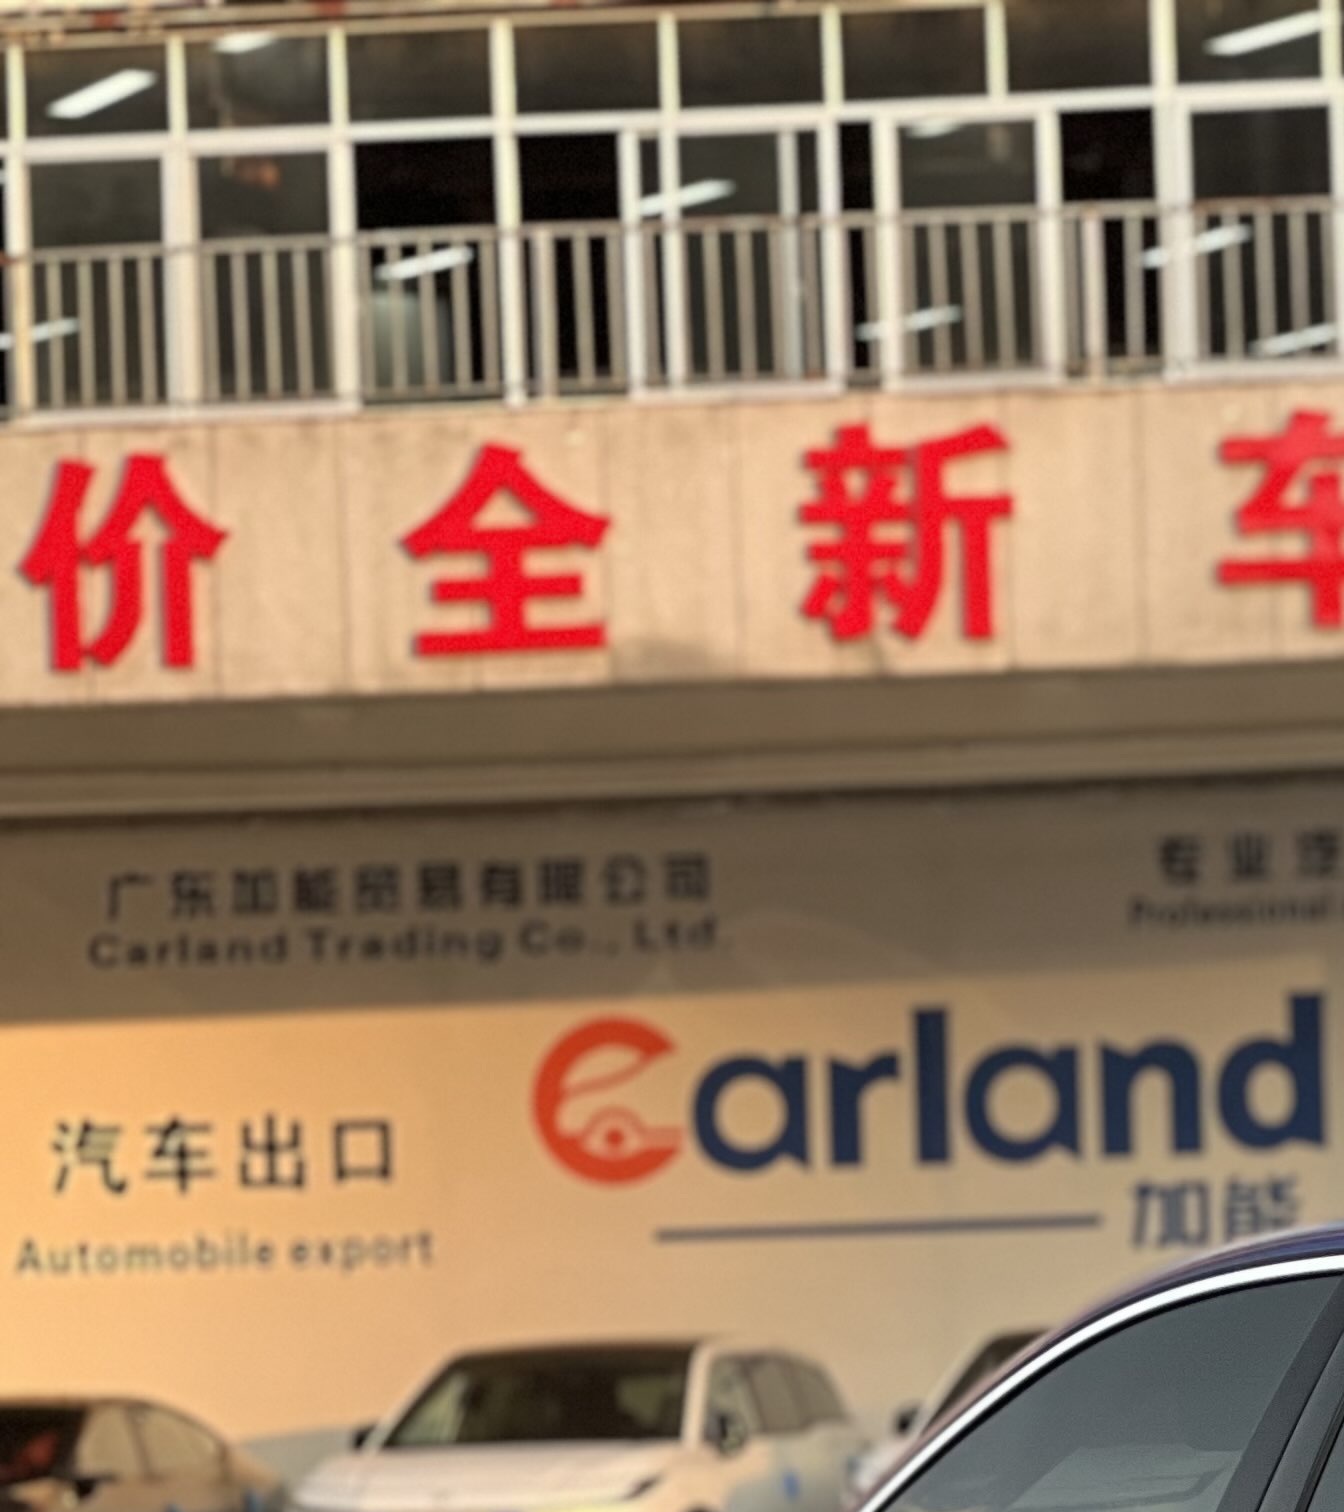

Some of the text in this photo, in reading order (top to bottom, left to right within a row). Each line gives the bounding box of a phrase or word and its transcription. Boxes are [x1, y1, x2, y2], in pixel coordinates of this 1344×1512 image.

[88, 929, 289, 970] Carland
[307, 922, 506, 967] Trading
[52, 1114, 394, 1196] 汽车出口
[14, 1228, 434, 1277] Automobile export
